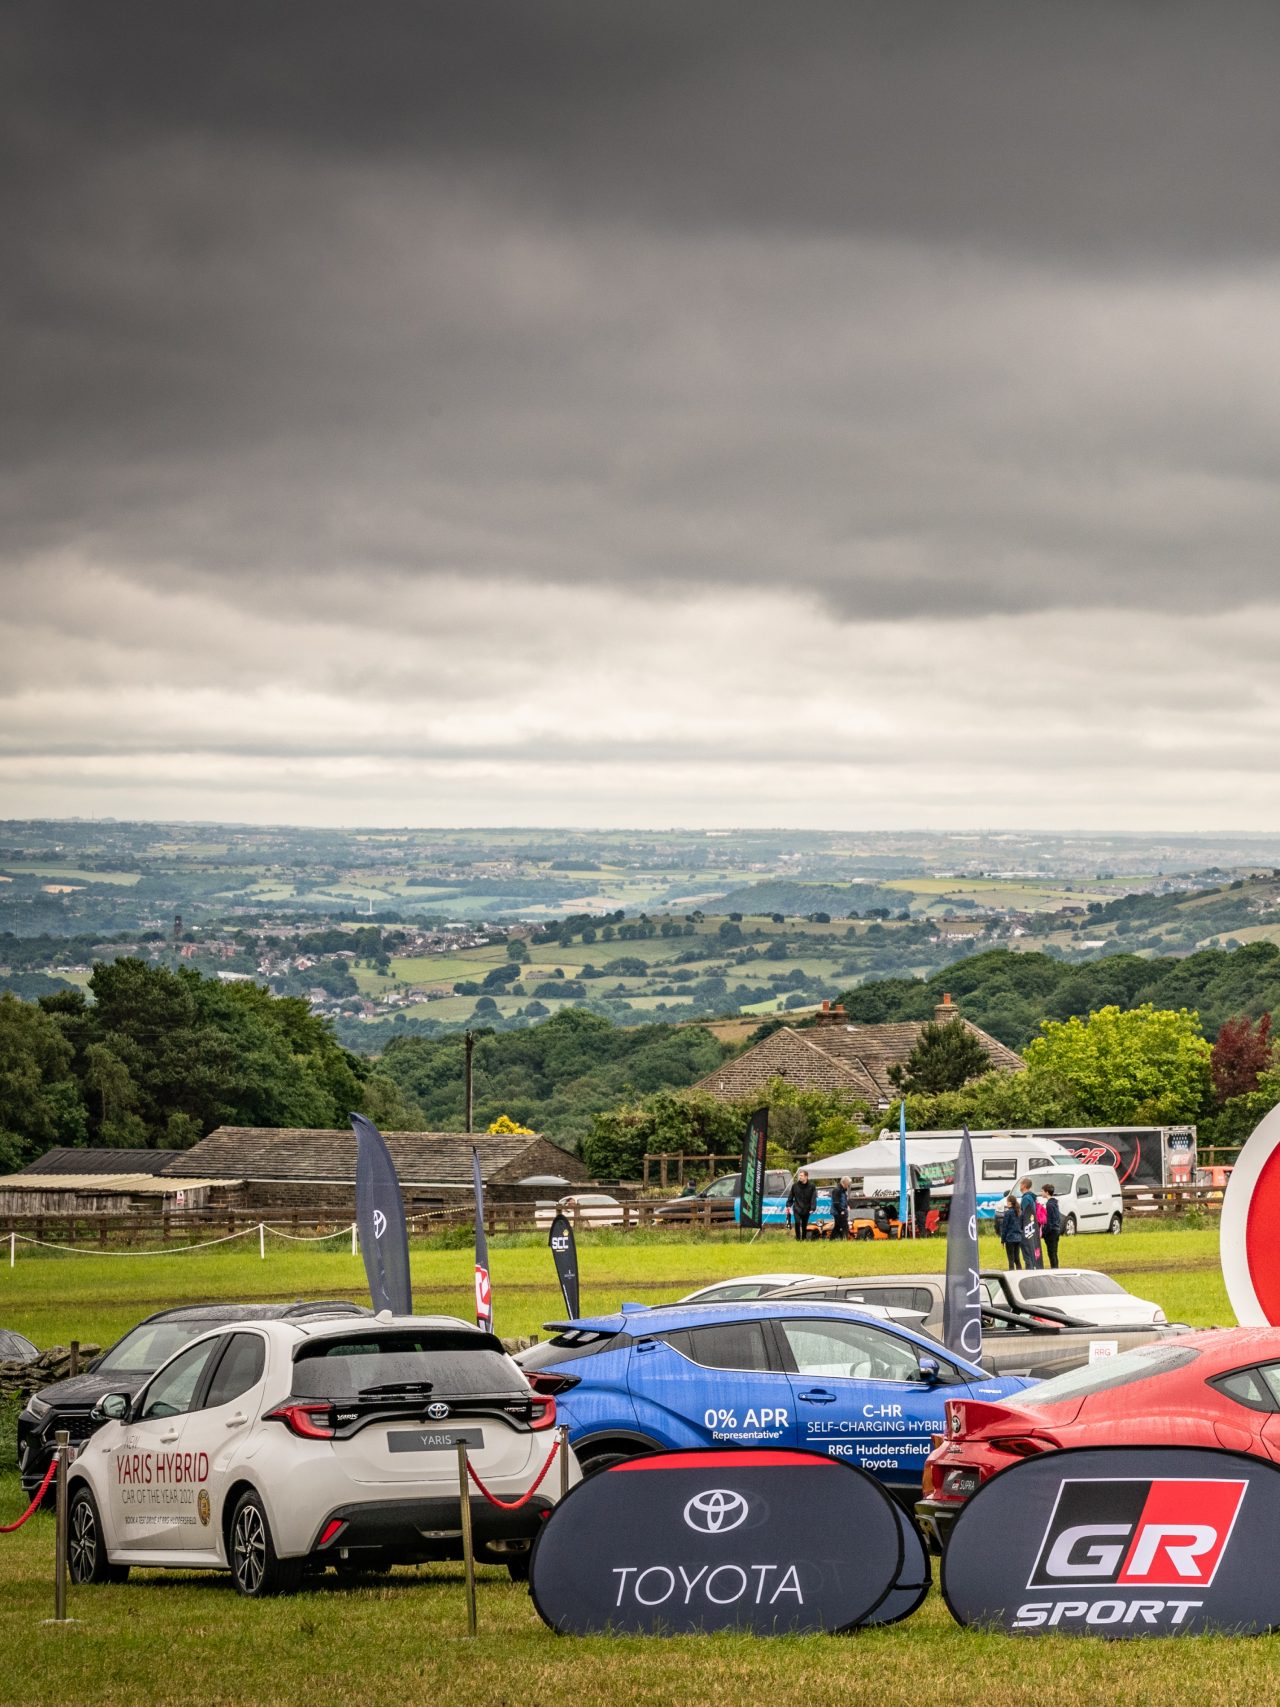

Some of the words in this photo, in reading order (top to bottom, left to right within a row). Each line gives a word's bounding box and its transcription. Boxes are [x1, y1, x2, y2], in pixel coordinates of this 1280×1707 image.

[552, 1237, 569, 1249] SCC
[1094, 1348, 1111, 1356] RRG
[862, 1404, 902, 1418] C-HR
[704, 1409, 738, 1428] 0%
[743, 1408, 789, 1428] APR
[807, 1420, 906, 1433] SELF-CHARGING
[421, 1435, 452, 1446] YARIS
[828, 1445, 853, 1456] RRG
[856, 1443, 931, 1456] Huddersfield
[116, 1453, 152, 1484] YARIS
[156, 1452, 209, 1483] HYBRID
[860, 1458, 898, 1470] Toyota
[960, 1480, 975, 1490] SUPRA
[122, 1489, 136, 1504] CAR
[137, 1489, 147, 1504] OF
[147, 1489, 161, 1504] THE
[161, 1489, 178, 1504] YEAR
[180, 1489, 194, 1504] 2021
[1045, 1523, 1218, 1577] GR
[612, 1564, 804, 1607] TOYOTA
[1011, 1600, 1204, 1628] SPORT
